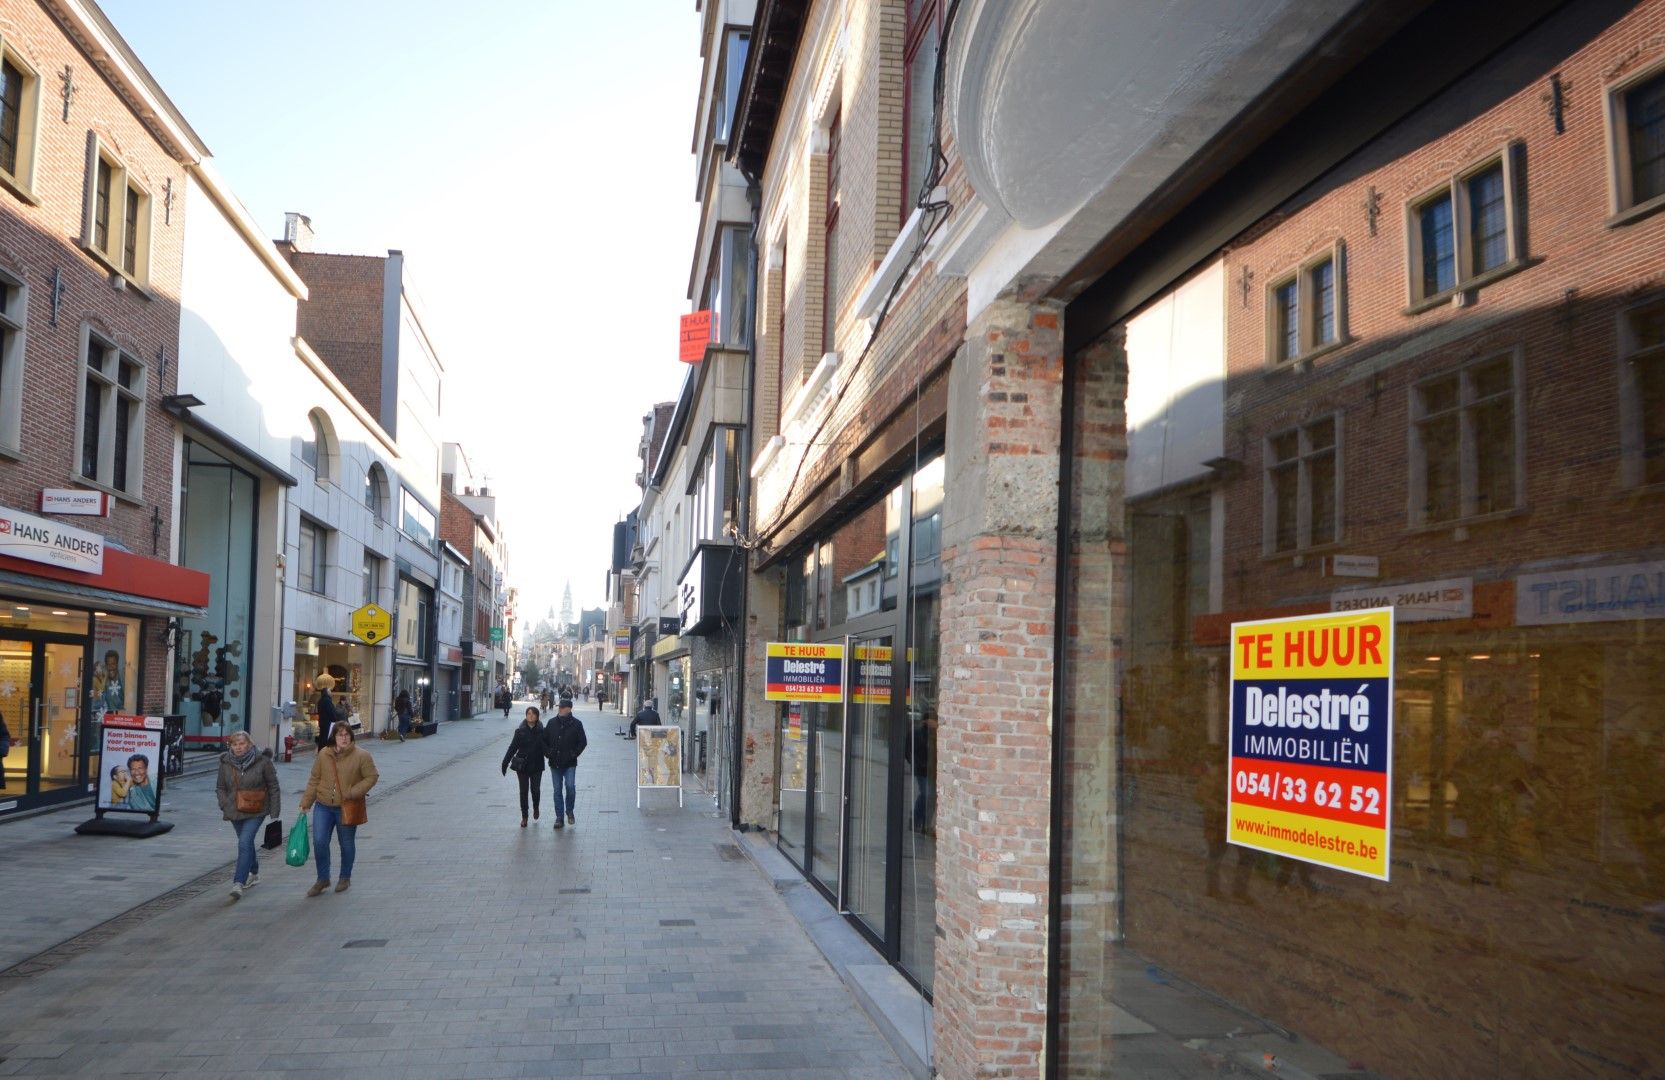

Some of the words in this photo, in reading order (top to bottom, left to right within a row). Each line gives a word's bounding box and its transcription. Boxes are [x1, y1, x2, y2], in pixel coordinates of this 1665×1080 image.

[13, 522, 50, 543] HANS
[54, 534, 99, 556] ANDERS
[784, 645, 796, 656] TE
[799, 646, 826, 657] HUUR
[1238, 633, 1273, 669] TE
[1284, 623, 1383, 668] HUUR
[784, 660, 825, 674] Delestré
[784, 675, 825, 683] IMMOBILIËN
[1245, 683, 1370, 732] Delestré
[107, 731, 123, 739] Kom
[124, 732, 148, 740] binnen
[137, 740, 157, 748] gratis
[106, 745, 136, 753] hoortest
[1244, 734, 1369, 765] IMMOBILIËN
[1235, 771, 1307, 803] 054/33
[1314, 781, 1342, 809] 62
[1349, 785, 1380, 815] 52
[1235, 816, 1378, 860] www.immodelestre.be
